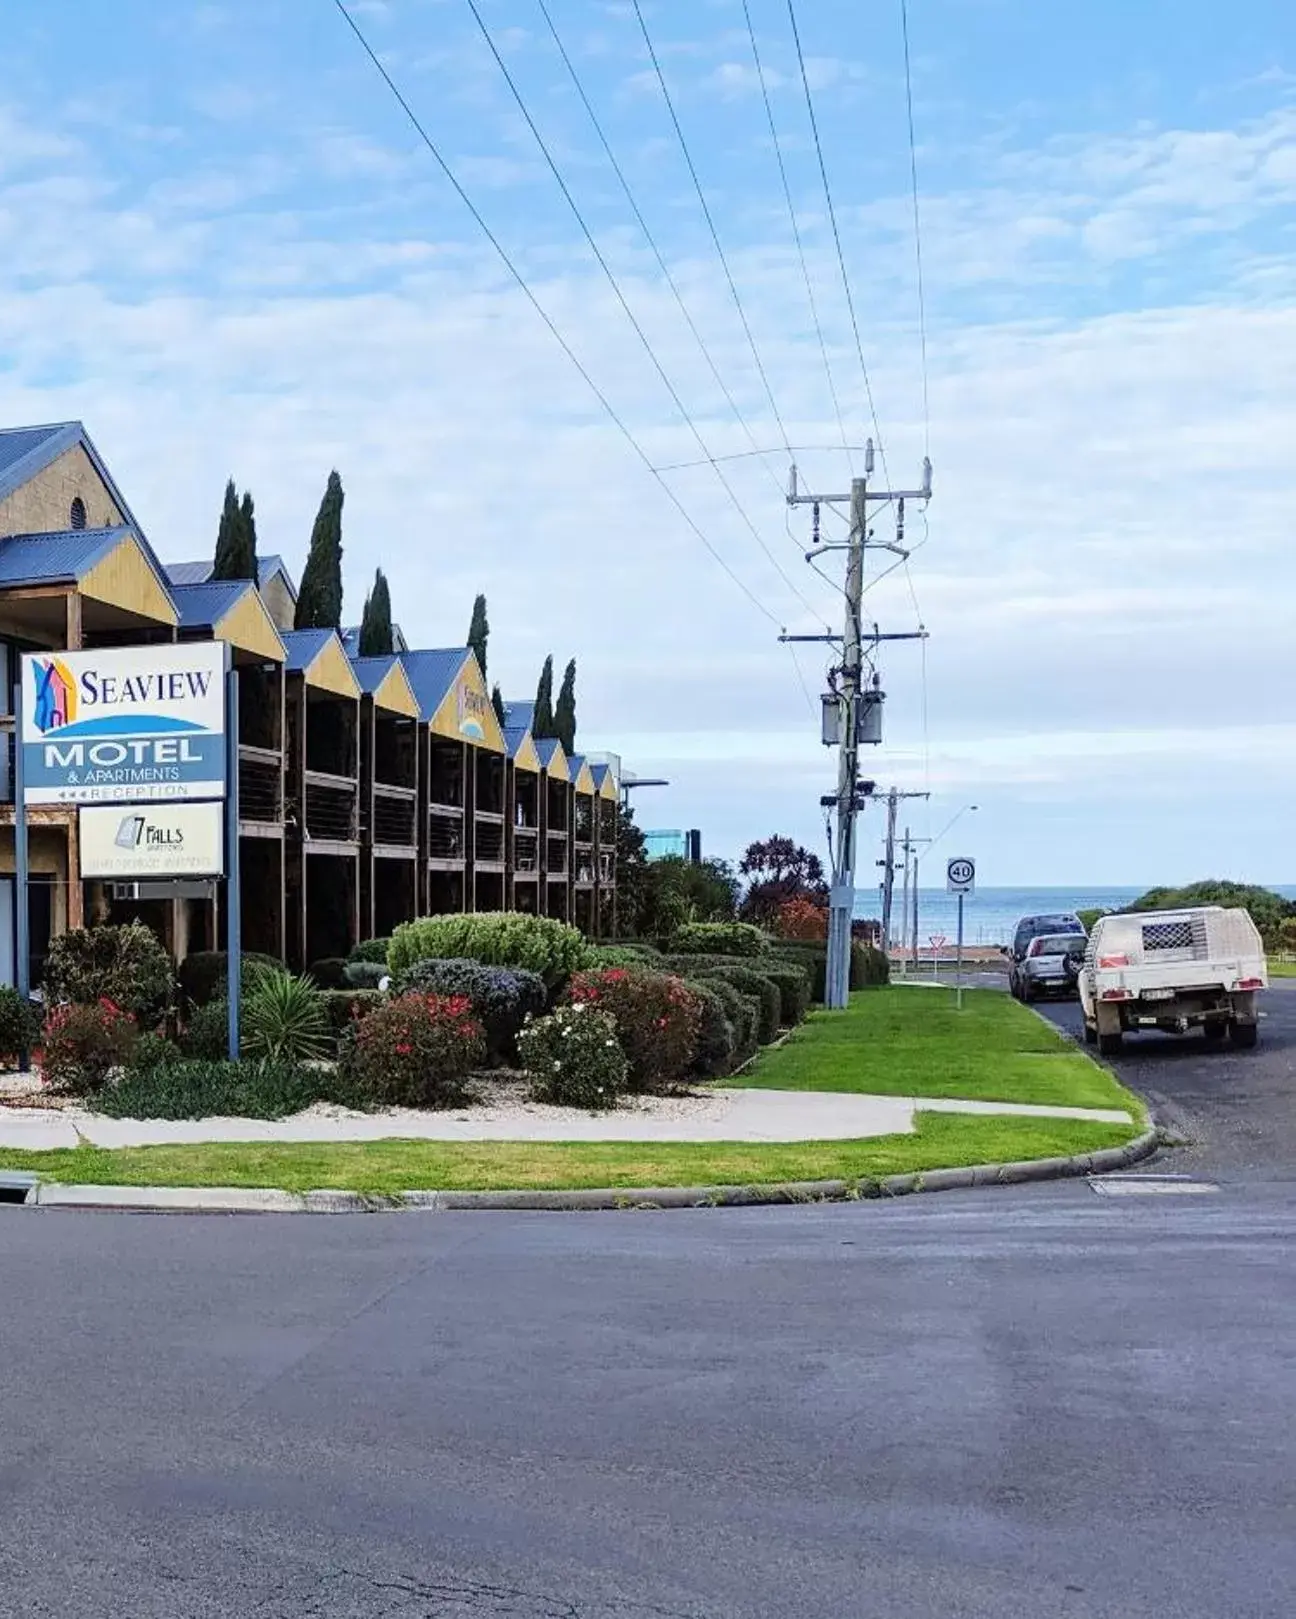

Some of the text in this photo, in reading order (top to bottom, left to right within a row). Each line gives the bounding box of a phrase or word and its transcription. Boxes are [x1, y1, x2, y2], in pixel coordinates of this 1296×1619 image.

[80, 671, 212, 706] SEAVIEW
[45, 739, 203, 768] MOTEL
[68, 768, 180, 784] & APARTMENTS
[91, 785, 188, 799] RECEPTION
[134, 817, 184, 845] 7 FALLS
[953, 867, 971, 878] 40
